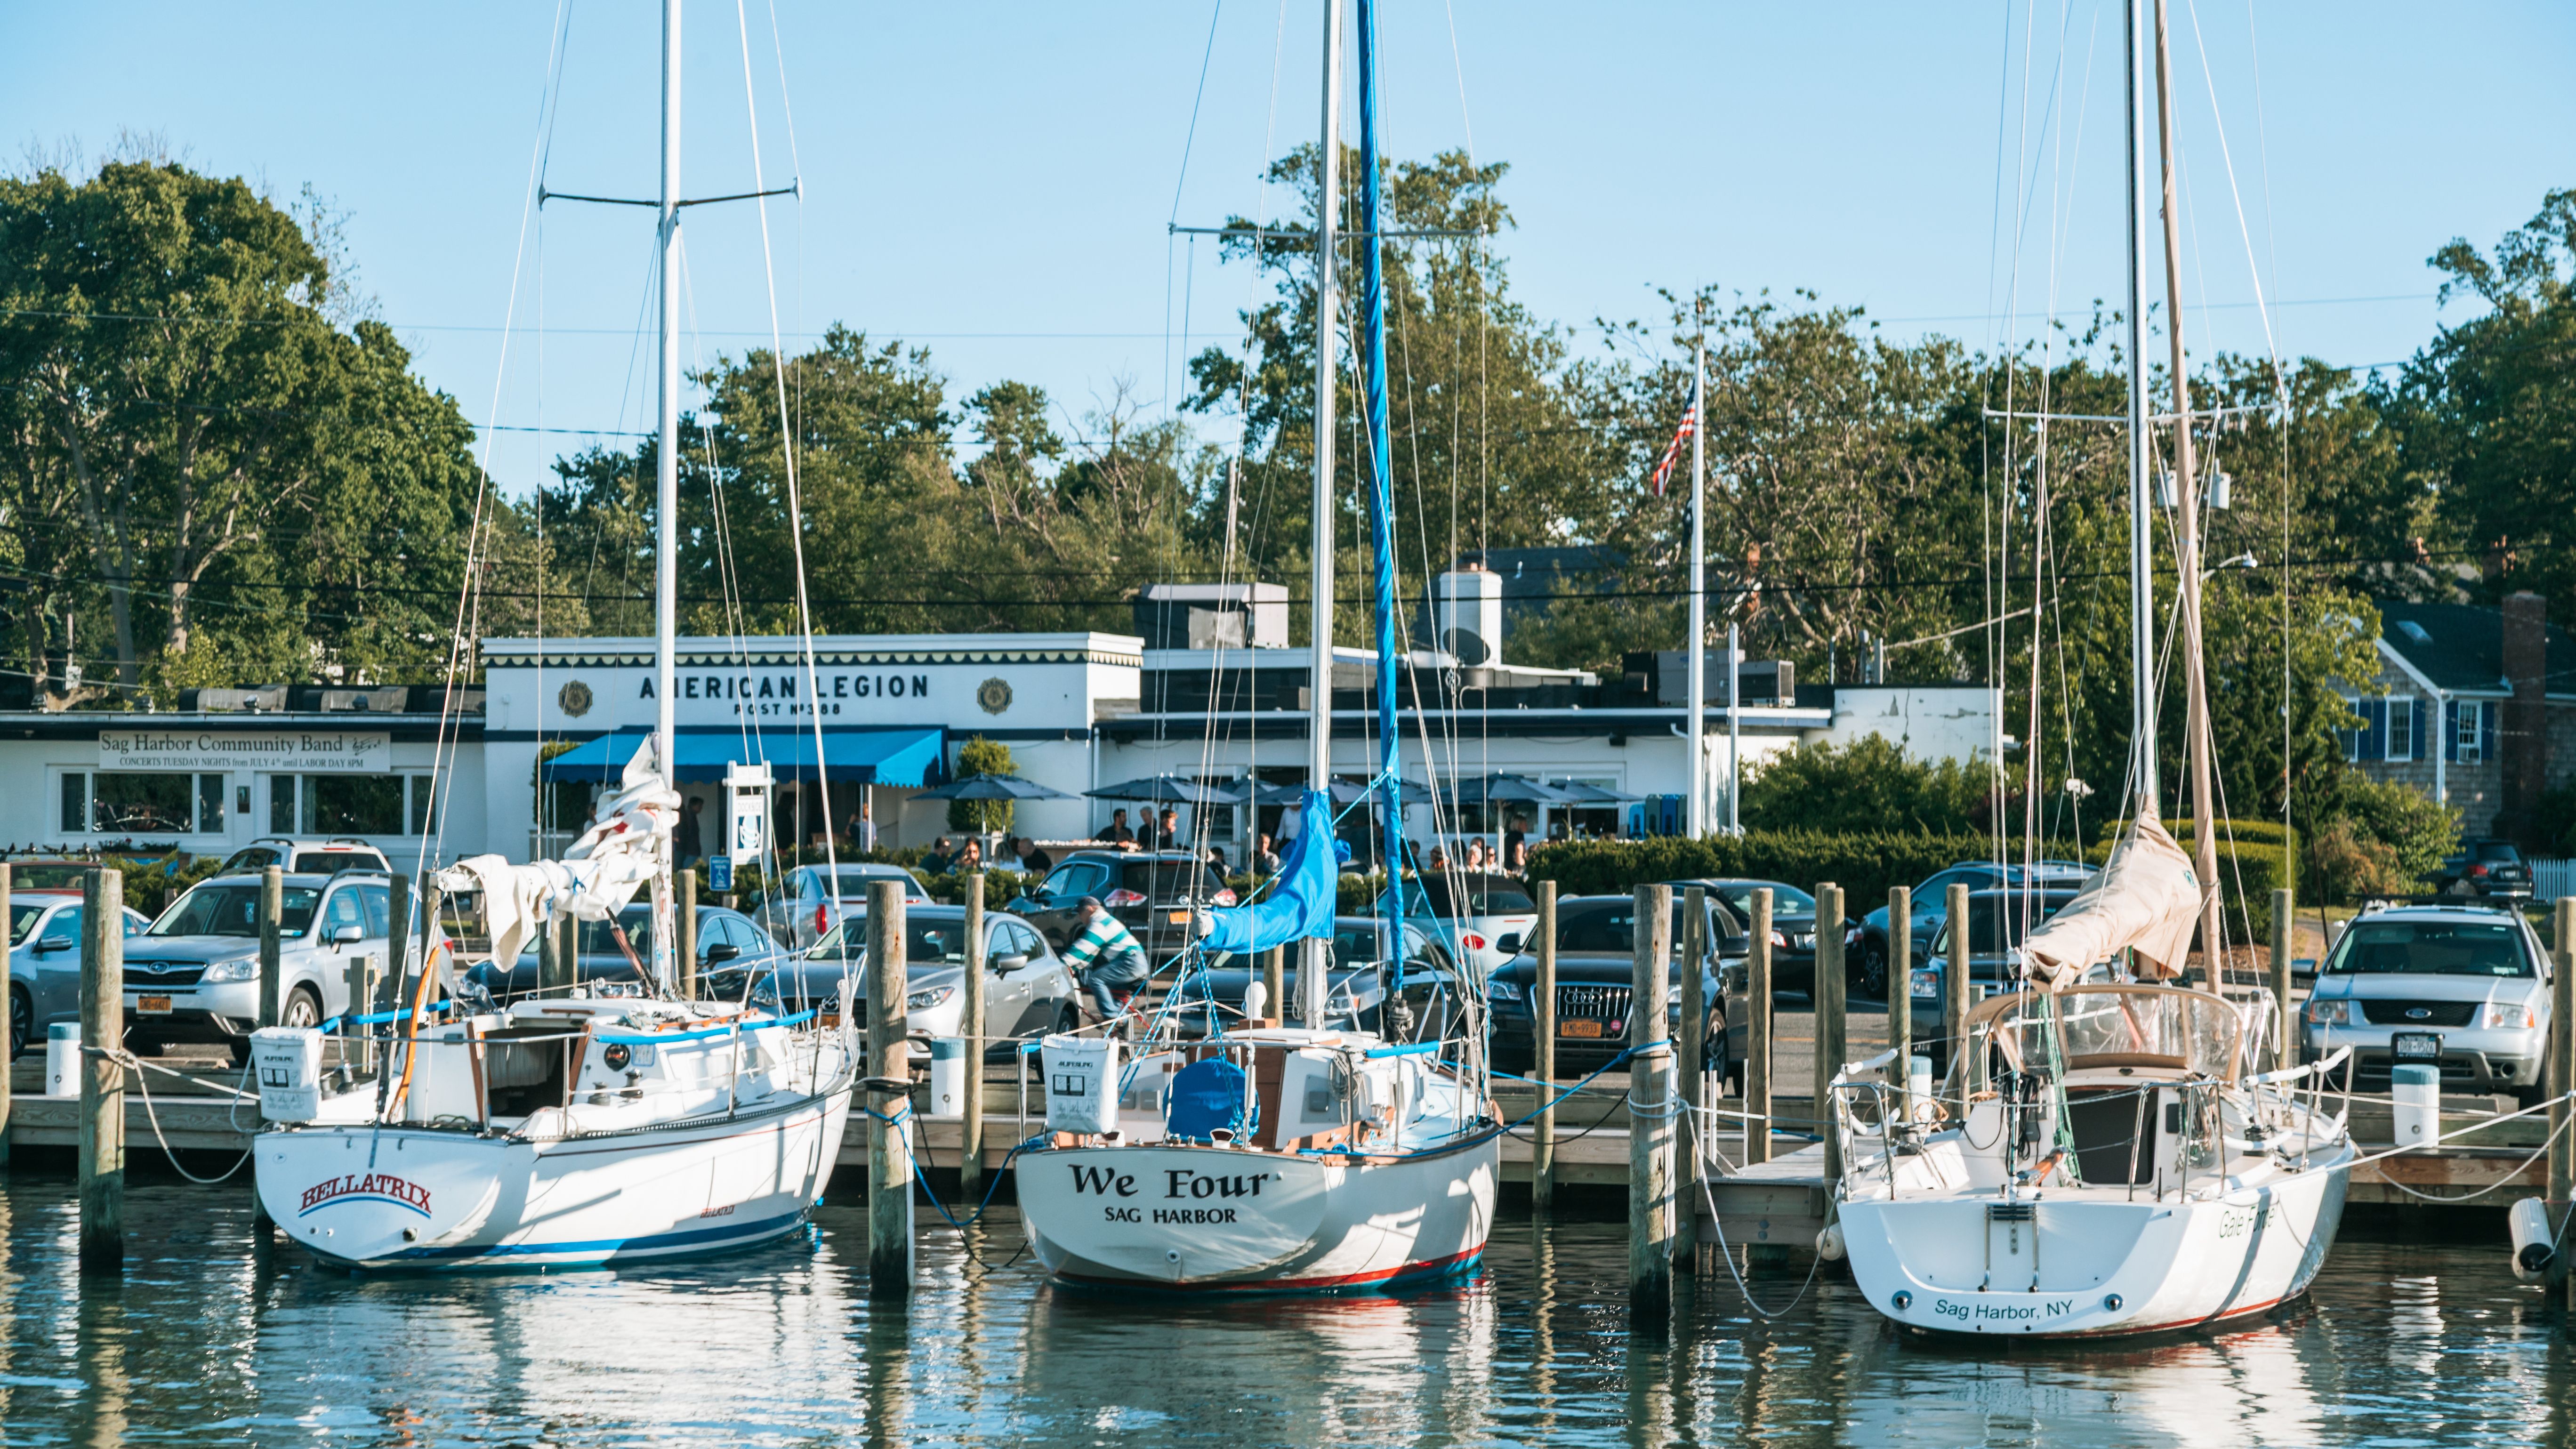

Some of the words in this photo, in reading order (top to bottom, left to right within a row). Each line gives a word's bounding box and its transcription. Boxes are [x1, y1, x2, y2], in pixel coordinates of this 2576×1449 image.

[640, 676, 796, 698] AERICAN
[814, 675, 927, 698] LEGION
[734, 703, 781, 715] POST
[102, 734, 129, 754] Sag
[134, 734, 192, 751] Harbor
[198, 734, 295, 755] Community
[300, 734, 343, 751] Band
[120, 757, 161, 767] CONCERTS
[162, 757, 199, 767] TUESDAY
[201, 757, 231, 767] NIGHTS
[233, 757, 248, 767] from
[250, 758, 268, 767] JULY
[282, 758, 298, 767] until
[299, 758, 326, 768] LABOR
[328, 758, 346, 768] DAY
[347, 758, 363, 768] 8PM
[1068, 1164, 1139, 1196] We
[1163, 1169, 1270, 1199] Four
[298, 1173, 432, 1214] BELLATRIX
[1104, 1207, 1142, 1223] SAG
[1153, 1208, 1237, 1224] HARBOR
[2219, 1209, 2244, 1238] Gale
[2245, 1206, 2276, 1234] Force
[1935, 1299, 1969, 1320] Sag
[1976, 1304, 2040, 1320] Harbor,
[2047, 1299, 2072, 1317] NY
